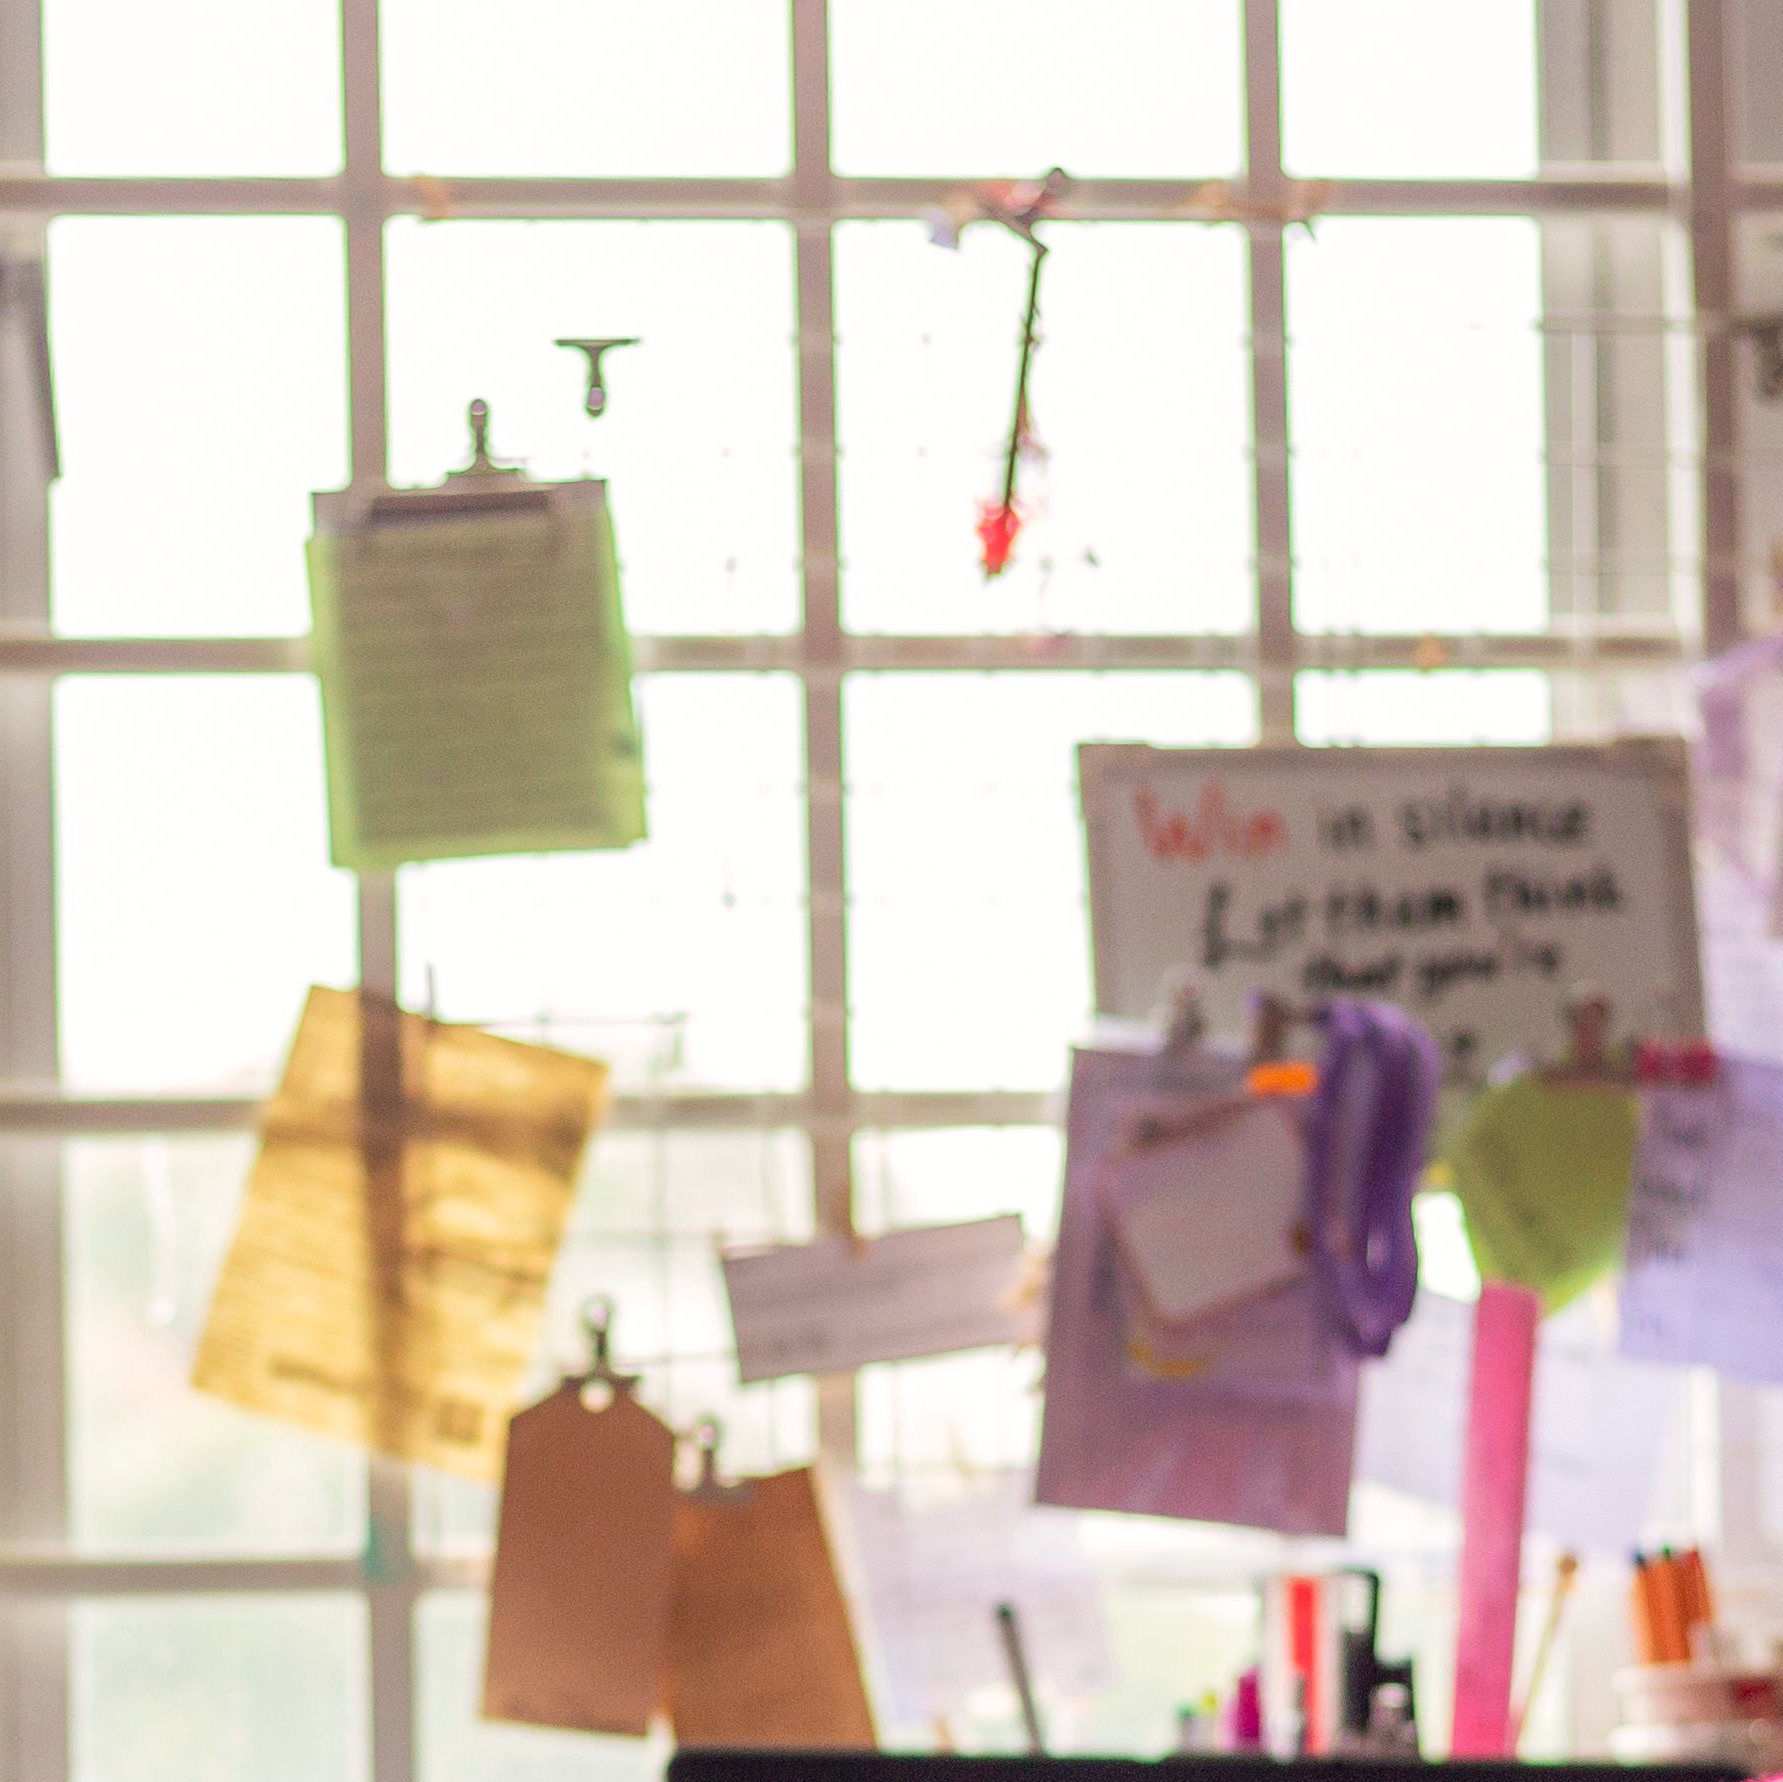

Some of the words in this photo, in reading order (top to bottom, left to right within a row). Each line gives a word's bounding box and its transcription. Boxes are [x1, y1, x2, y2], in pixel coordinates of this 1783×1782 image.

[1132, 783, 1286, 863] Win
[1320, 800, 1372, 850] in
[1402, 789, 1591, 848] silence
[1323, 886, 1464, 932] them
